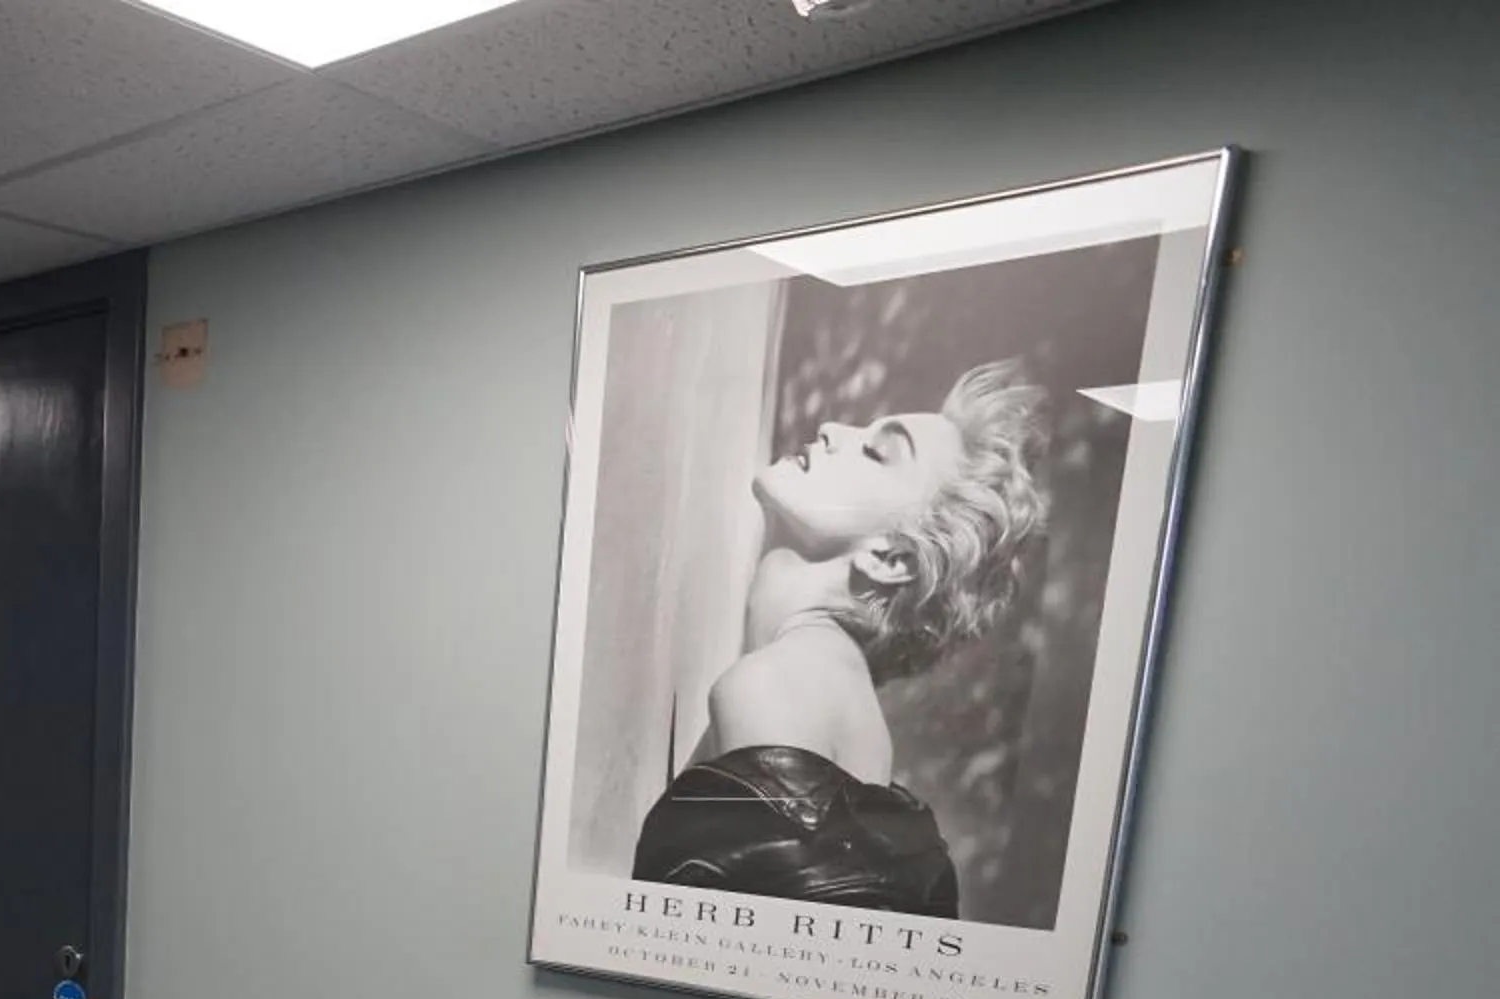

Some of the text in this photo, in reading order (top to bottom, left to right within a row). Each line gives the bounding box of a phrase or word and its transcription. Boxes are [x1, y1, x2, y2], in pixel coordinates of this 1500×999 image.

[624, 892, 965, 957] HERB RITTS
[607, 945, 717, 973] OCTOBER
[717, 937, 829, 965] GALLERY
[850, 956, 899, 974] LOS
[909, 965, 1050, 996] ANGELES
